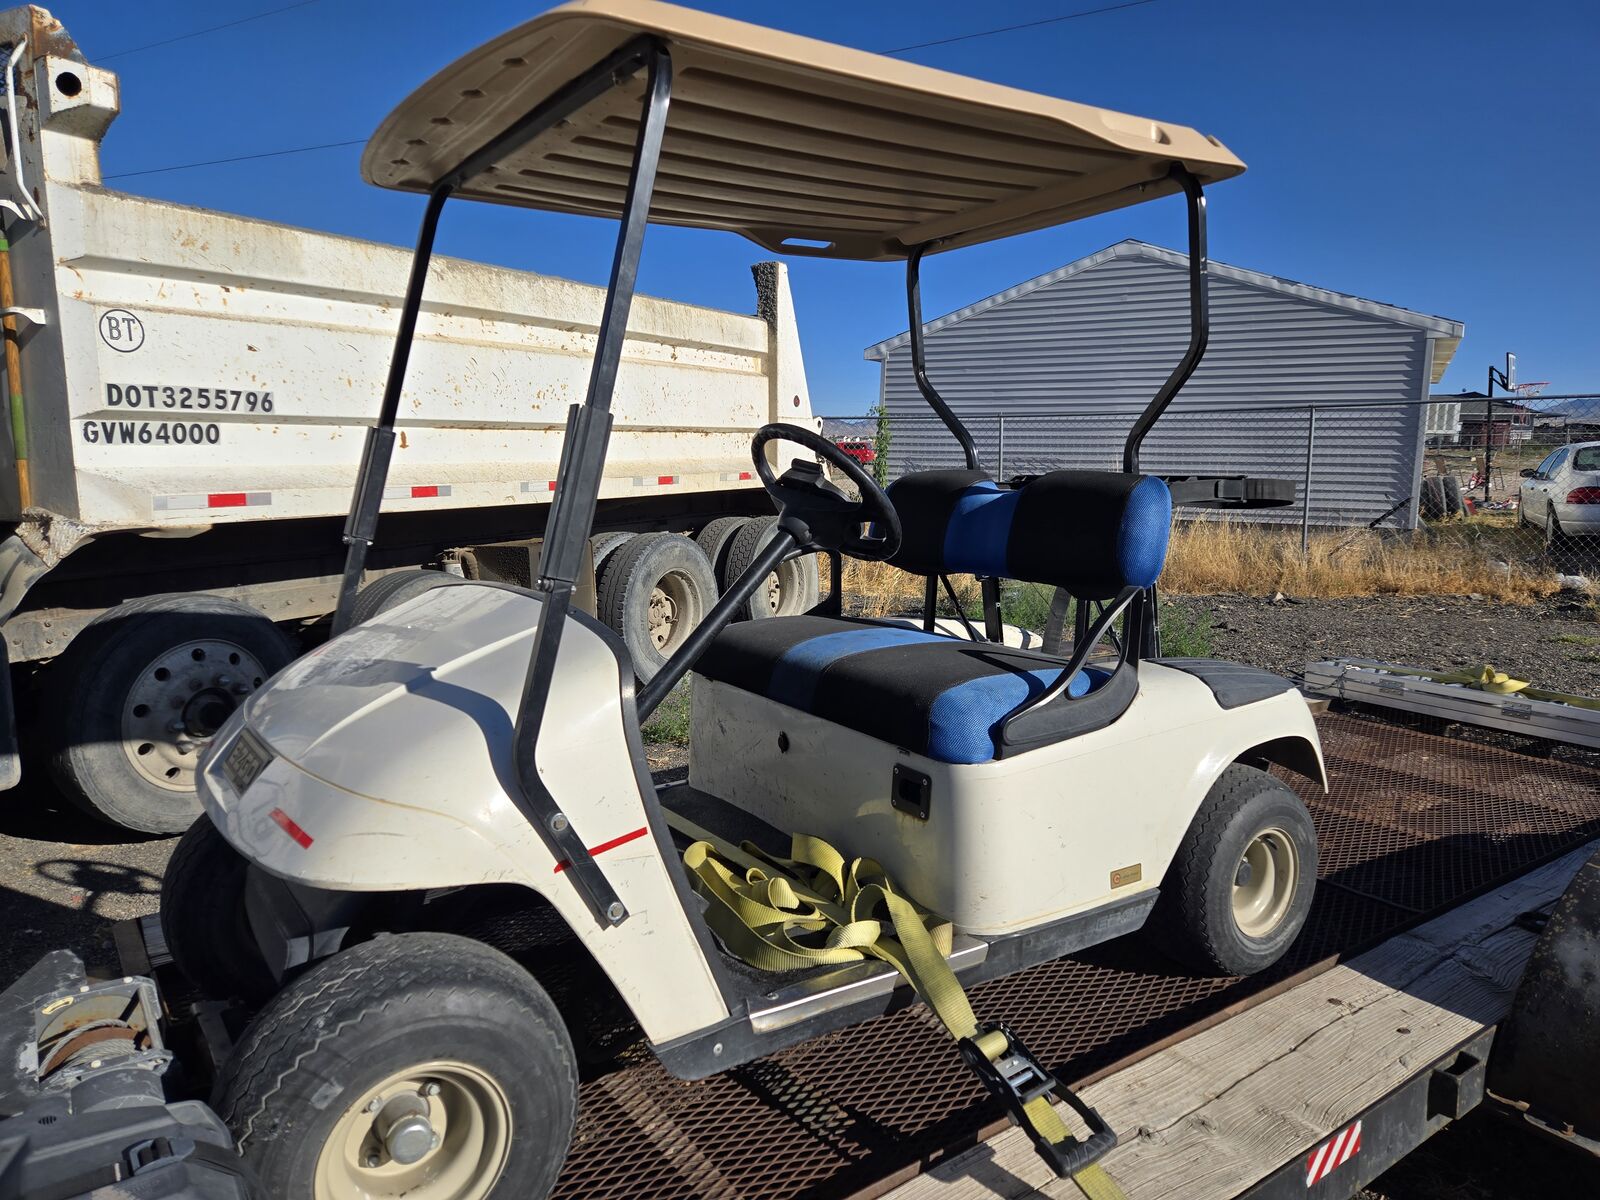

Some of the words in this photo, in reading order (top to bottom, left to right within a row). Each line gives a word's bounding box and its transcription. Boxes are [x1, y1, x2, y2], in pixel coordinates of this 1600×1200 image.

[106, 317, 137, 342] BT
[107, 383, 274, 413] DOT3255796
[83, 421, 220, 445] GVW64000
